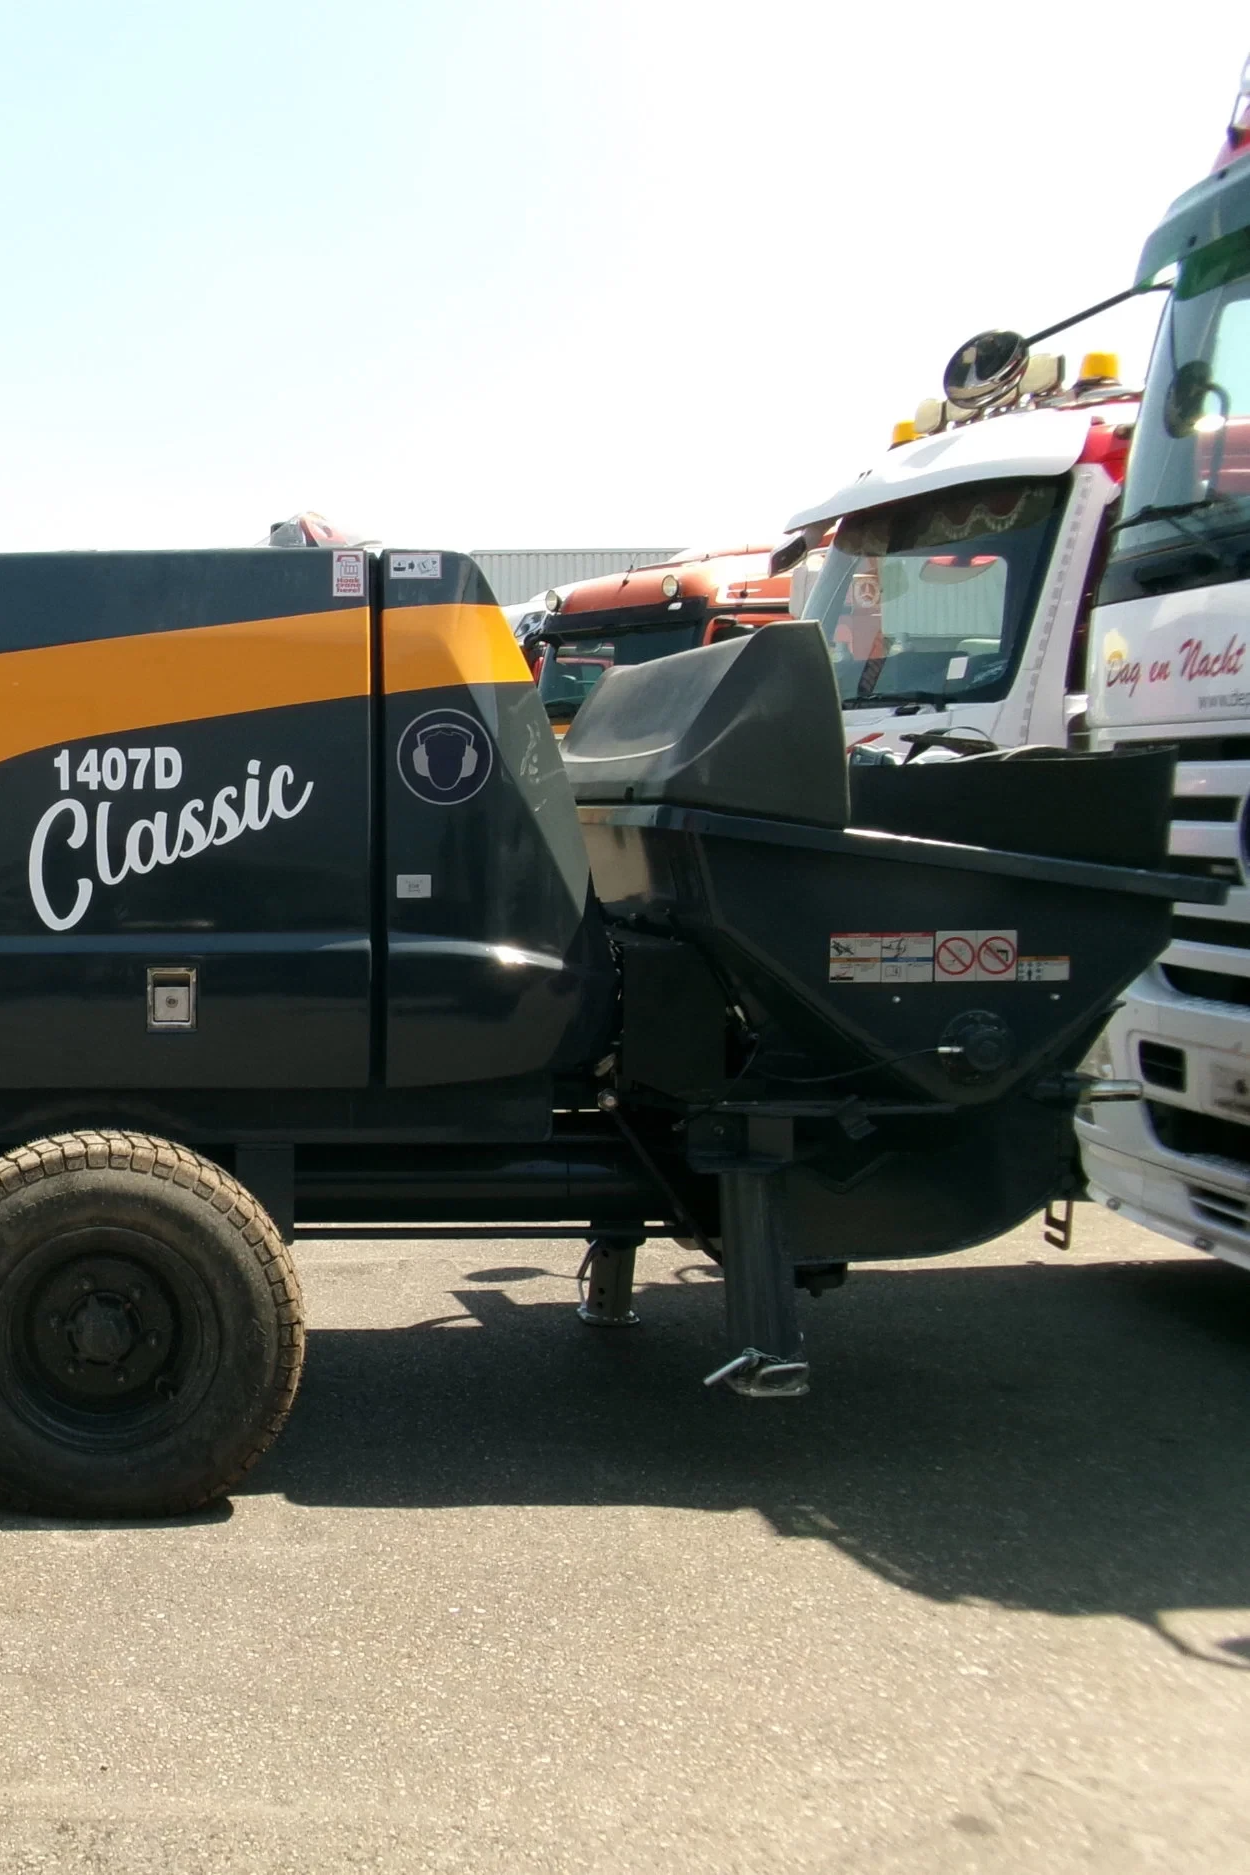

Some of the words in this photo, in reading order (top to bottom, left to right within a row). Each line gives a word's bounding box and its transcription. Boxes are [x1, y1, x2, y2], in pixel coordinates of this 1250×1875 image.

[1149, 660, 1171, 683] en
[53, 746, 183, 791] 1407D
[28, 758, 315, 931] Classic
